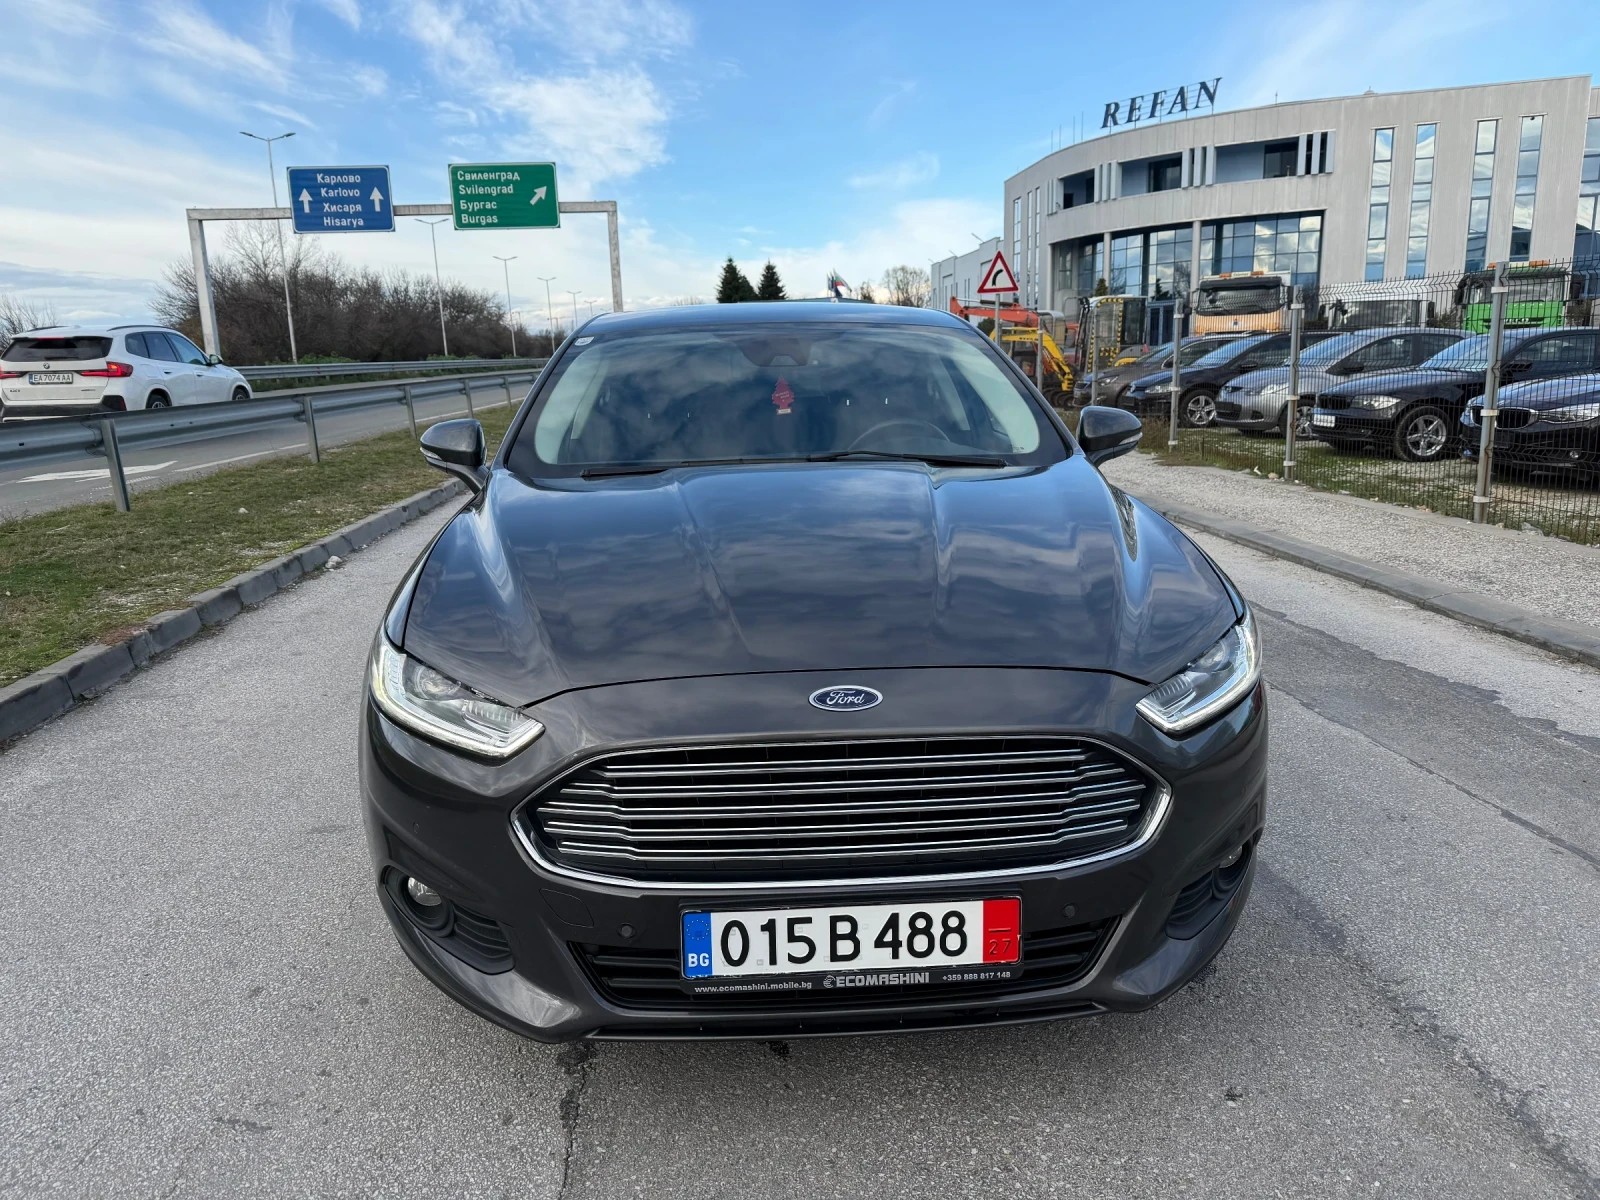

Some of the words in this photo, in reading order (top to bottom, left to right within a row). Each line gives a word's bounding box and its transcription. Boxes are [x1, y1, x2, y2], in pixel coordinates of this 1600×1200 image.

[1100, 77, 1222, 128] REFAN
[317, 173, 361, 185] Карлово
[457, 170, 520, 182] Свиленград
[320, 187, 360, 197] Karlovo
[459, 184, 514, 196] Svilengrad
[323, 202, 362, 214] Хисаря
[460, 200, 497, 212] Бургас
[323, 216, 364, 228] Hisarya
[461, 214, 498, 225] Burgas
[827, 691, 864, 704] Ford
[720, 916, 817, 967] 015
[829, 914, 861, 963] B
[874, 909, 968, 960] 488
[989, 938, 1011, 955] 27
[688, 952, 710, 968] BG
[836, 972, 930, 988] ECOMASHINI
[942, 974, 962, 982] +359
[963, 973, 978, 981] 888
[980, 972, 995, 980] 817
[996, 971, 1011, 979] 148
[694, 981, 812, 993] www.ecomashini.mobile.bg
